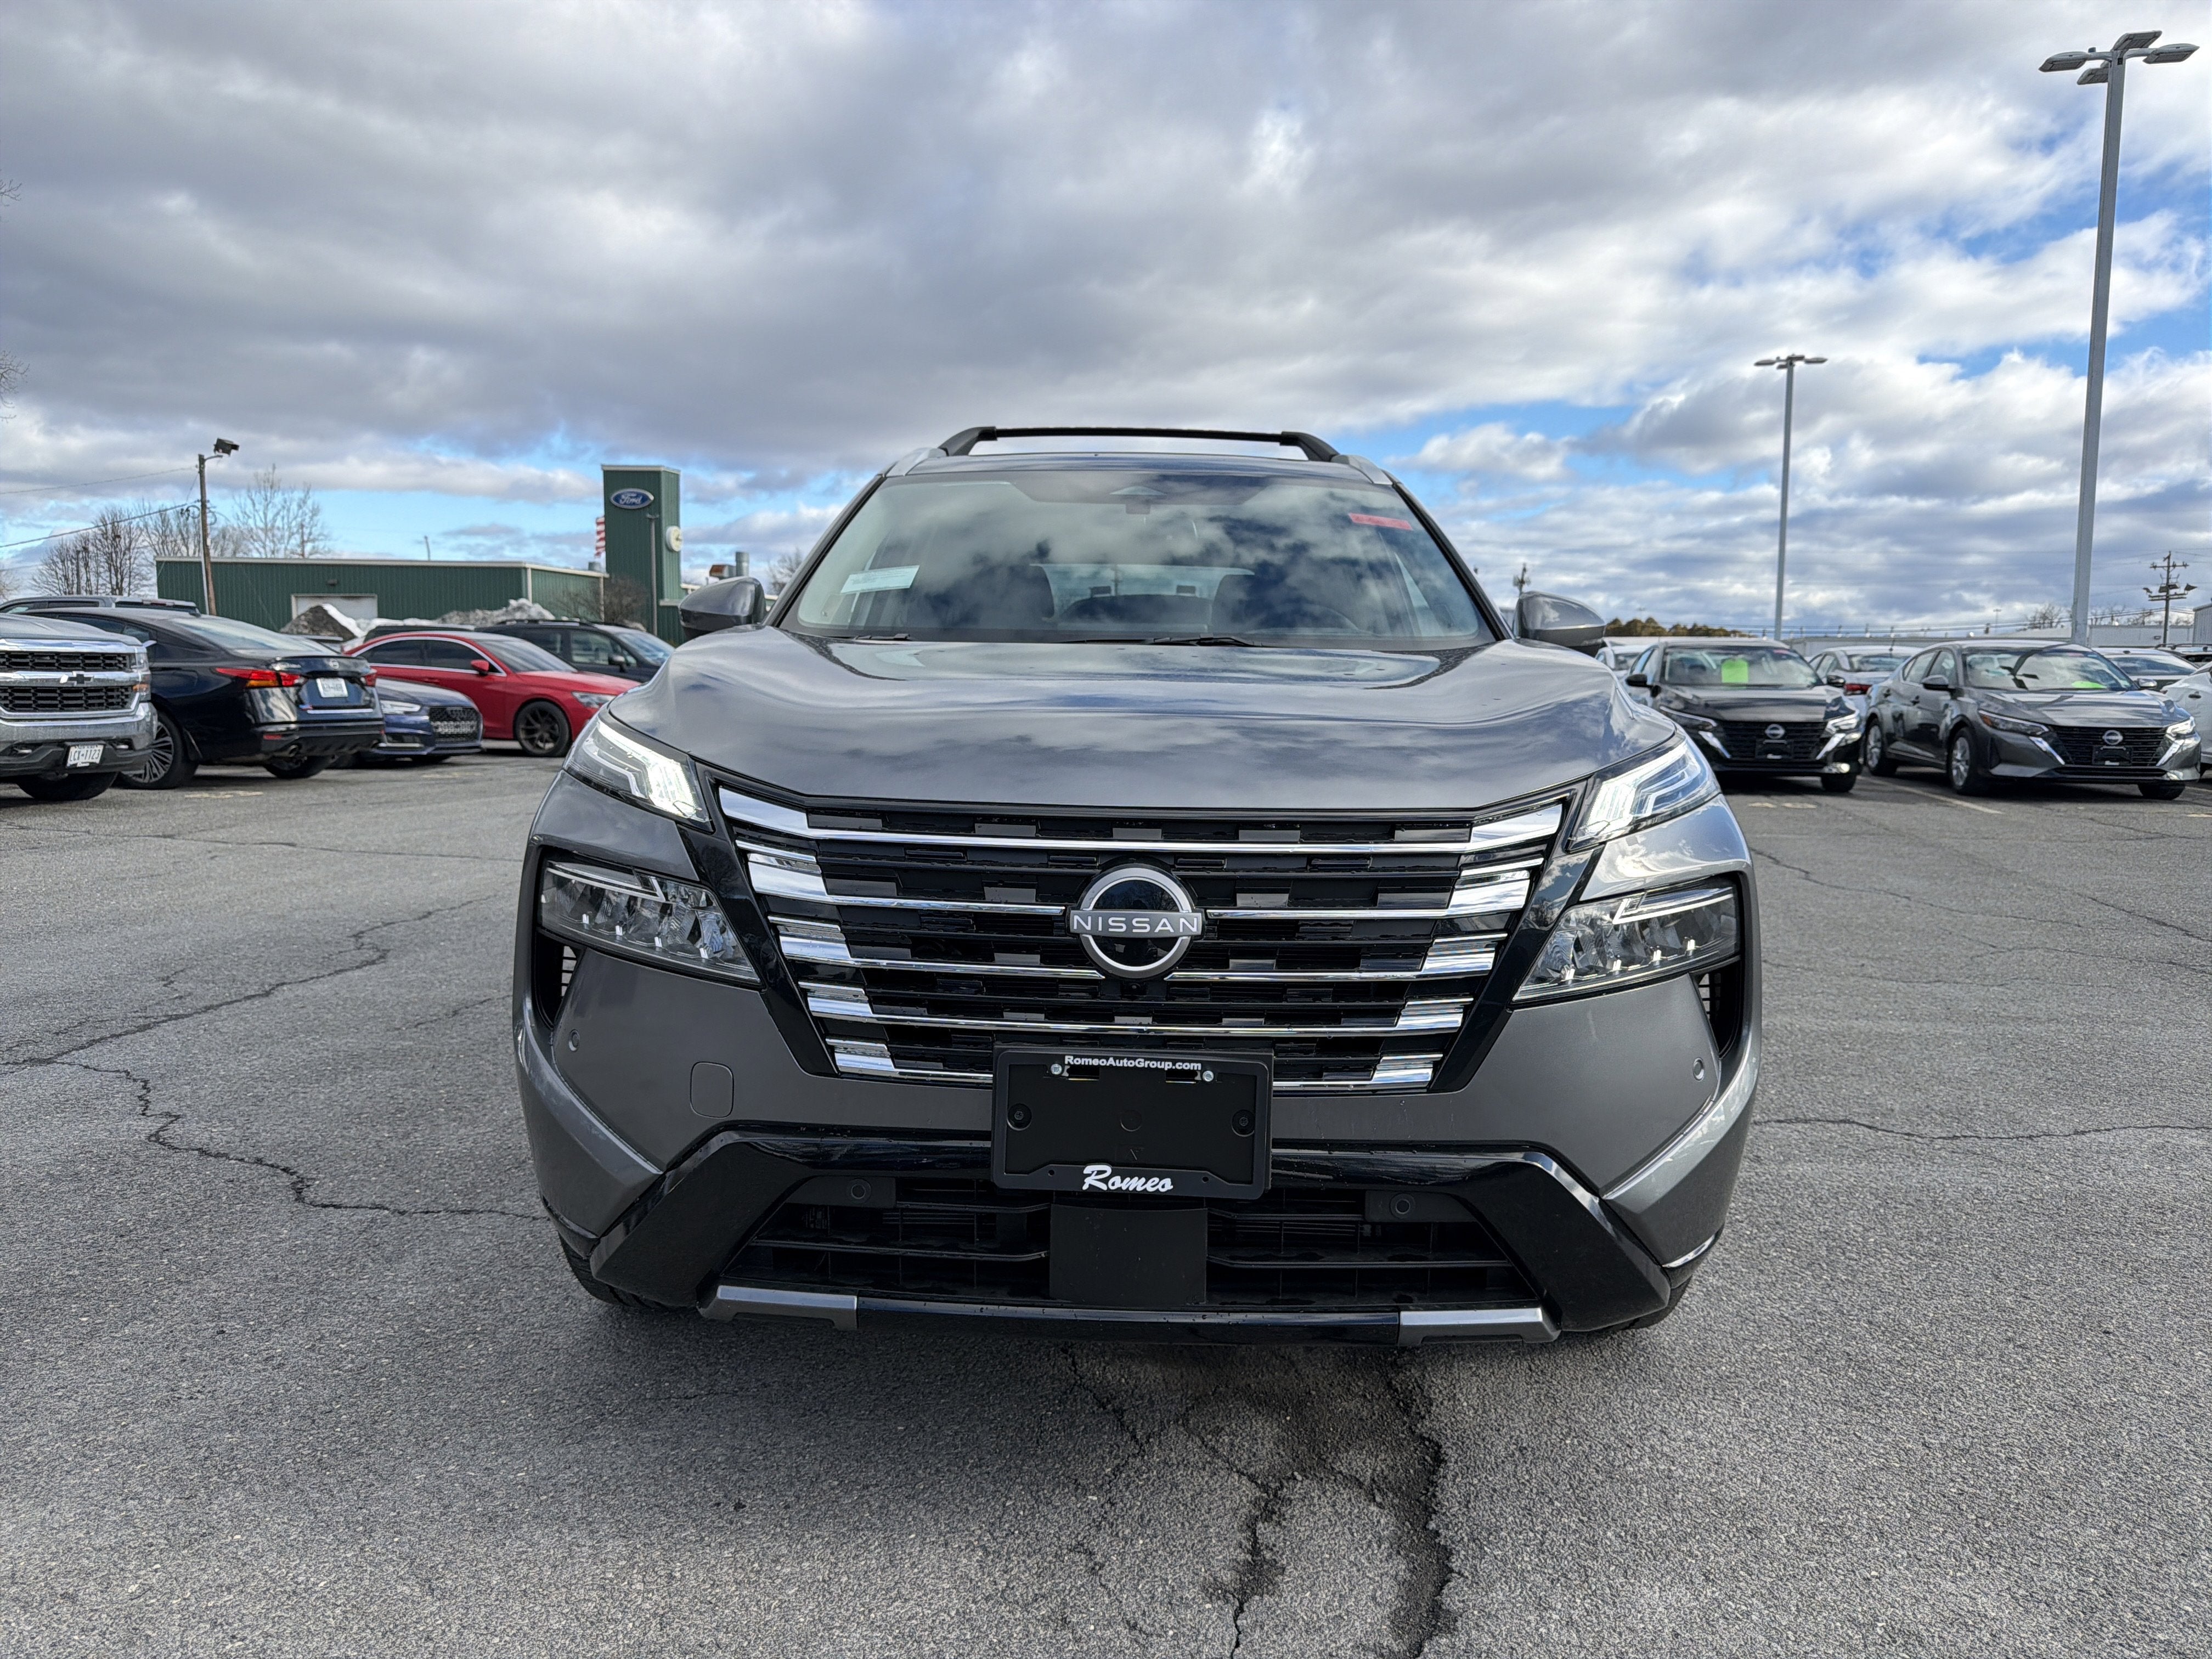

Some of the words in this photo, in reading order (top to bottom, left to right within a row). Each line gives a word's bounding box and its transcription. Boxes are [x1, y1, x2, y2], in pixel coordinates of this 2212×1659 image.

[619, 493, 643, 504] Ford
[1073, 915, 1197, 933] NISSAN
[1064, 1055, 1201, 1071] RomeoAutoGroup.com
[1082, 1164, 1173, 1192] Romeo
